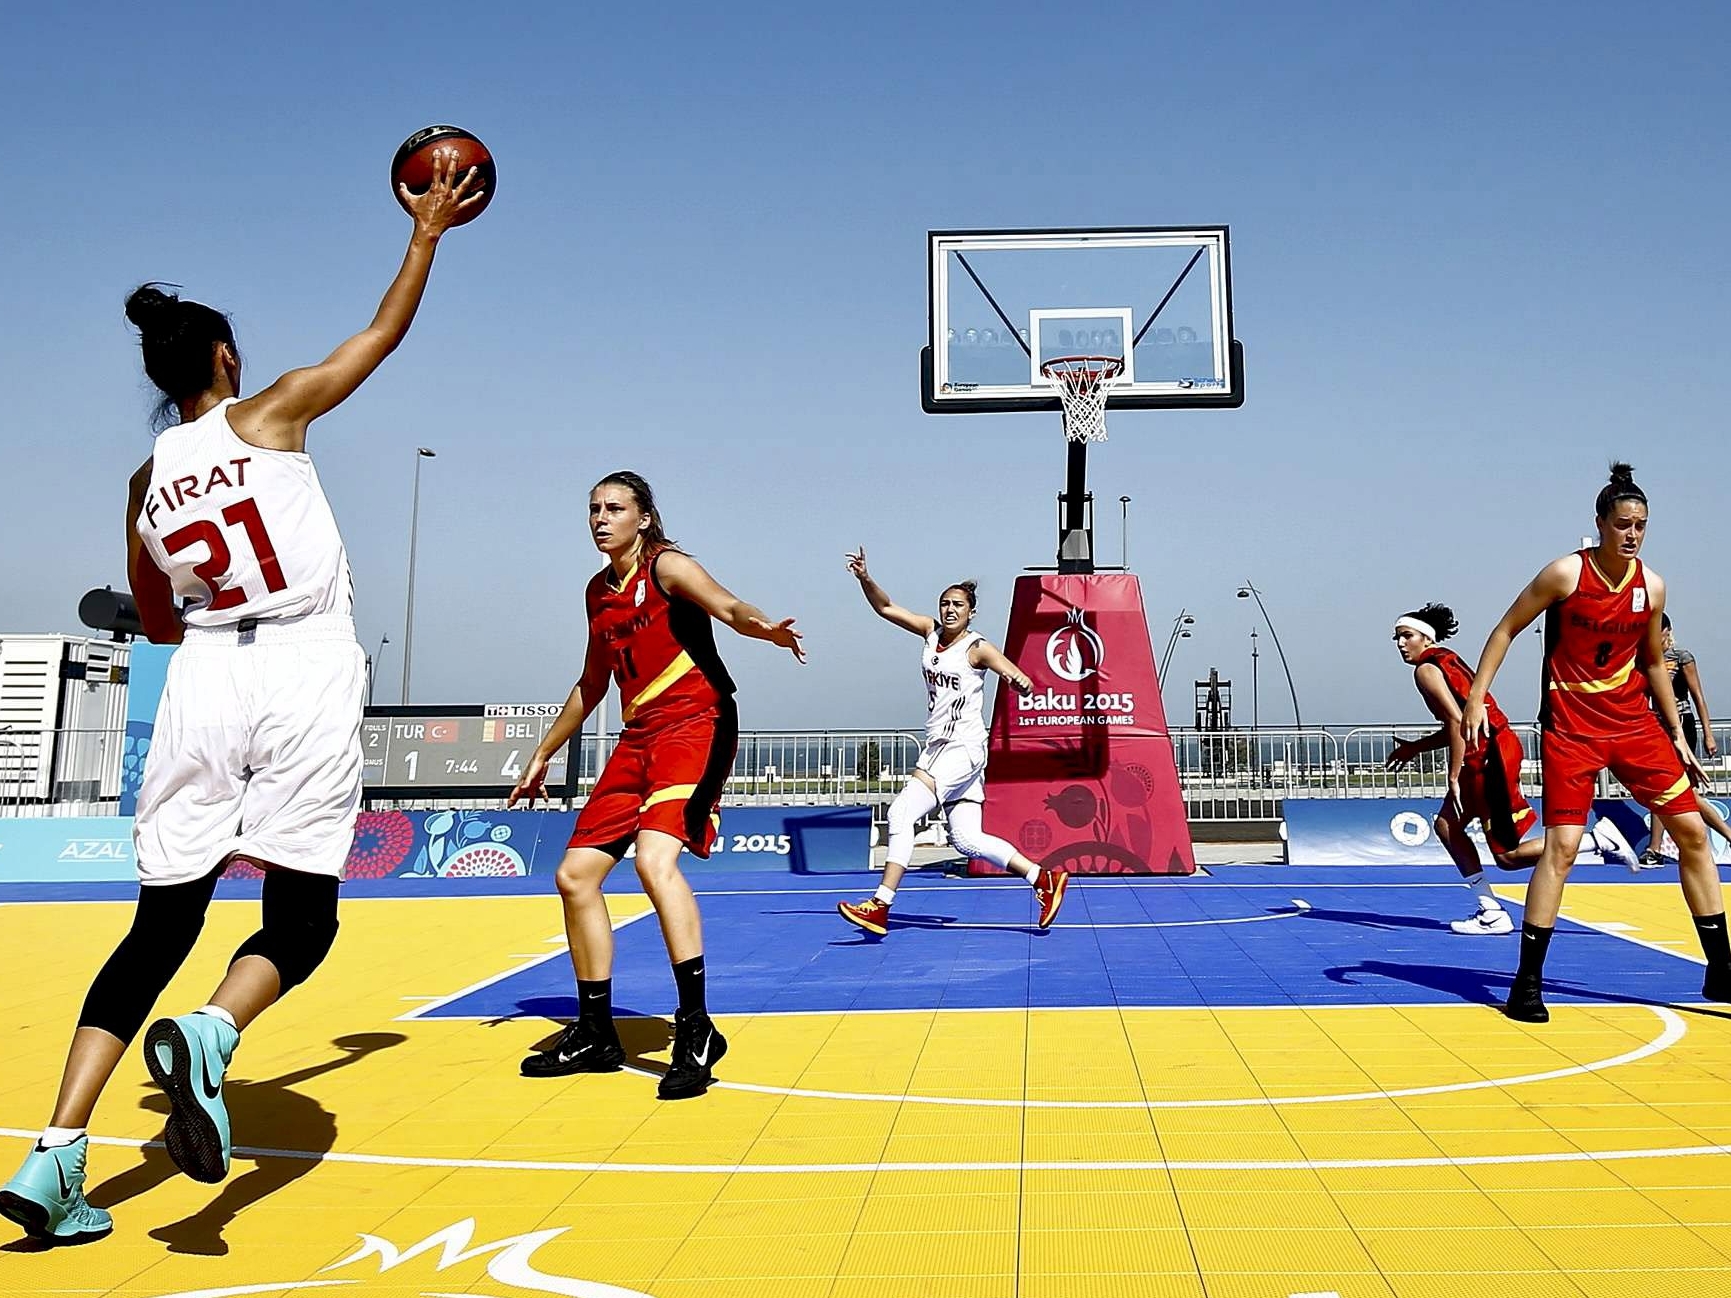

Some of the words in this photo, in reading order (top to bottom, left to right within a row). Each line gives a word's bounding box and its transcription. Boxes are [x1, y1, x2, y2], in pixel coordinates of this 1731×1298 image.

[145, 457, 251, 529] FIRAT
[161, 497, 288, 611] 21
[1594, 641, 1613, 667] 8
[1018, 687, 1077, 711] Baku
[1083, 693, 1134, 713] 2015
[1037, 715, 1095, 726] EUROPEAN
[1097, 715, 1135, 725] GAMES
[369, 733, 379, 747] 2
[394, 724, 424, 739] TUR
[505, 723, 535, 739] BEL
[364, 758, 384, 766] ONUS
[404, 751, 419, 781] 1
[445, 759, 478, 774] 7:44
[500, 750, 521, 780] 4
[58, 842, 129, 858] AZAL
[731, 834, 791, 854] 2015
